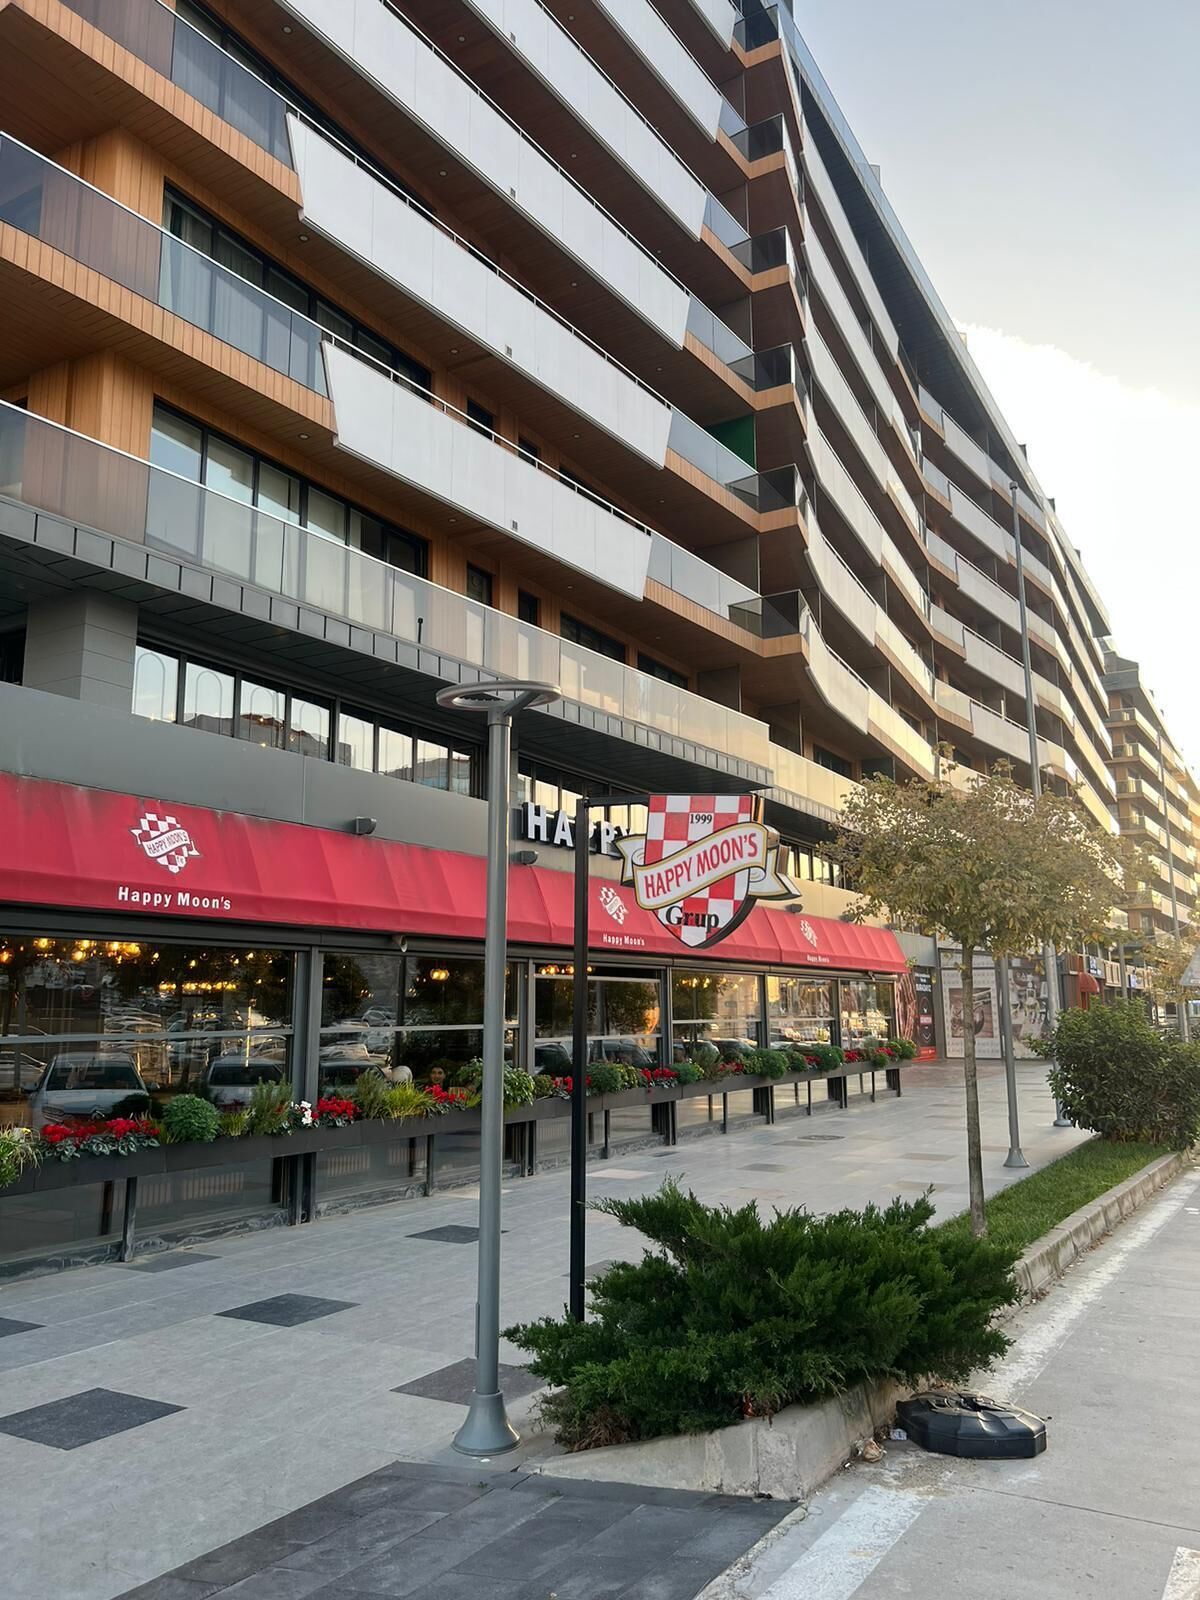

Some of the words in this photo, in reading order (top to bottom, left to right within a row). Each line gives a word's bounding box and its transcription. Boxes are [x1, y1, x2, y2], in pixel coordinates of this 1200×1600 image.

[690, 813, 713, 825] 1999
[146, 839, 168, 855] HAPPY
[643, 857, 694, 899] HAPPY
[696, 832, 759, 877] MOON'S
[118, 886, 172, 908] Happy
[177, 892, 231, 910] Moon's
[665, 905, 720, 934] Grup
[602, 933, 623, 946] Happy
